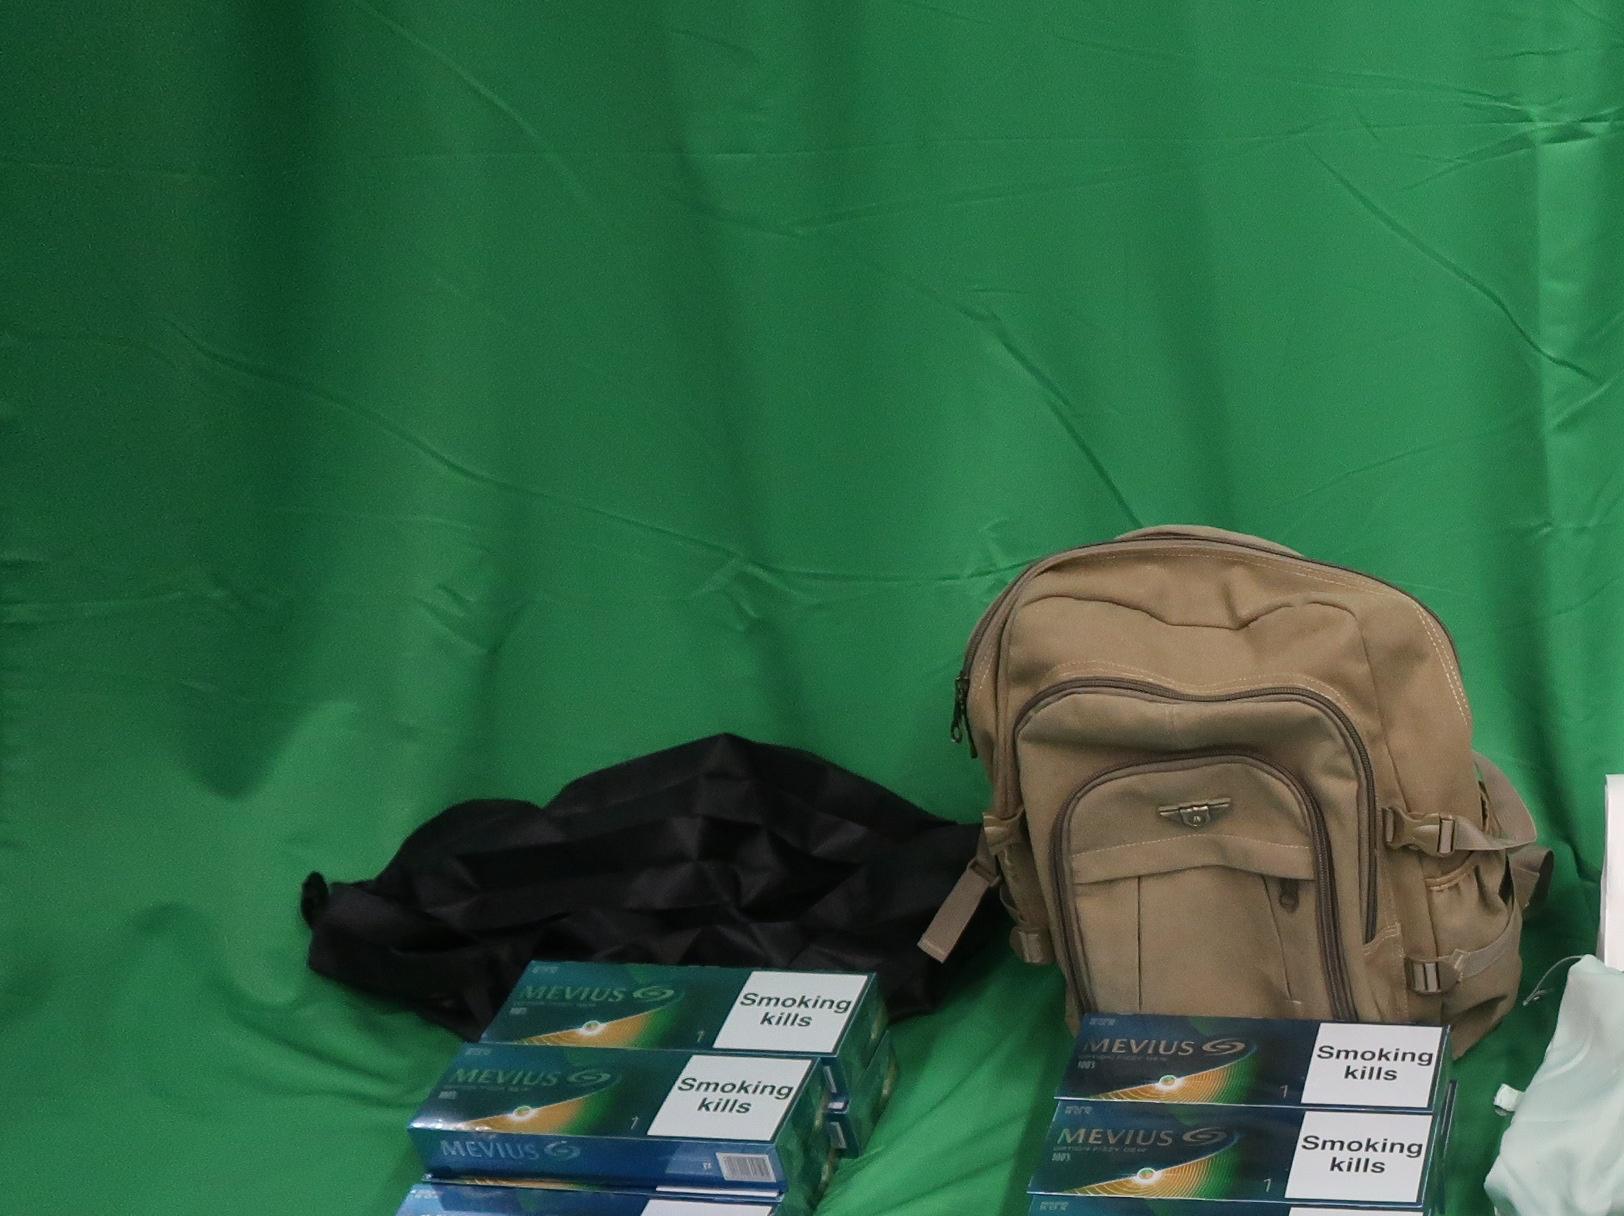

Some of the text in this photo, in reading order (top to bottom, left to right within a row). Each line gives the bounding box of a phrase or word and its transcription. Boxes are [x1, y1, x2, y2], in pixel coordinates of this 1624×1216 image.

[522, 984, 627, 1003] MEVIUS
[739, 992, 853, 1015] Smoking
[759, 1011, 813, 1028] kills
[1083, 1037, 1195, 1056] MEVIUS
[1316, 1044, 1434, 1067] Smoking
[1343, 1064, 1398, 1082] kills
[677, 1076, 795, 1101] Smoking
[696, 1096, 752, 1114] kills
[1058, 1128, 1173, 1147] MEVIUS
[1300, 1134, 1424, 1159] Smoking
[440, 1139, 539, 1161] MEVIUS
[1329, 1156, 1386, 1174] kills
